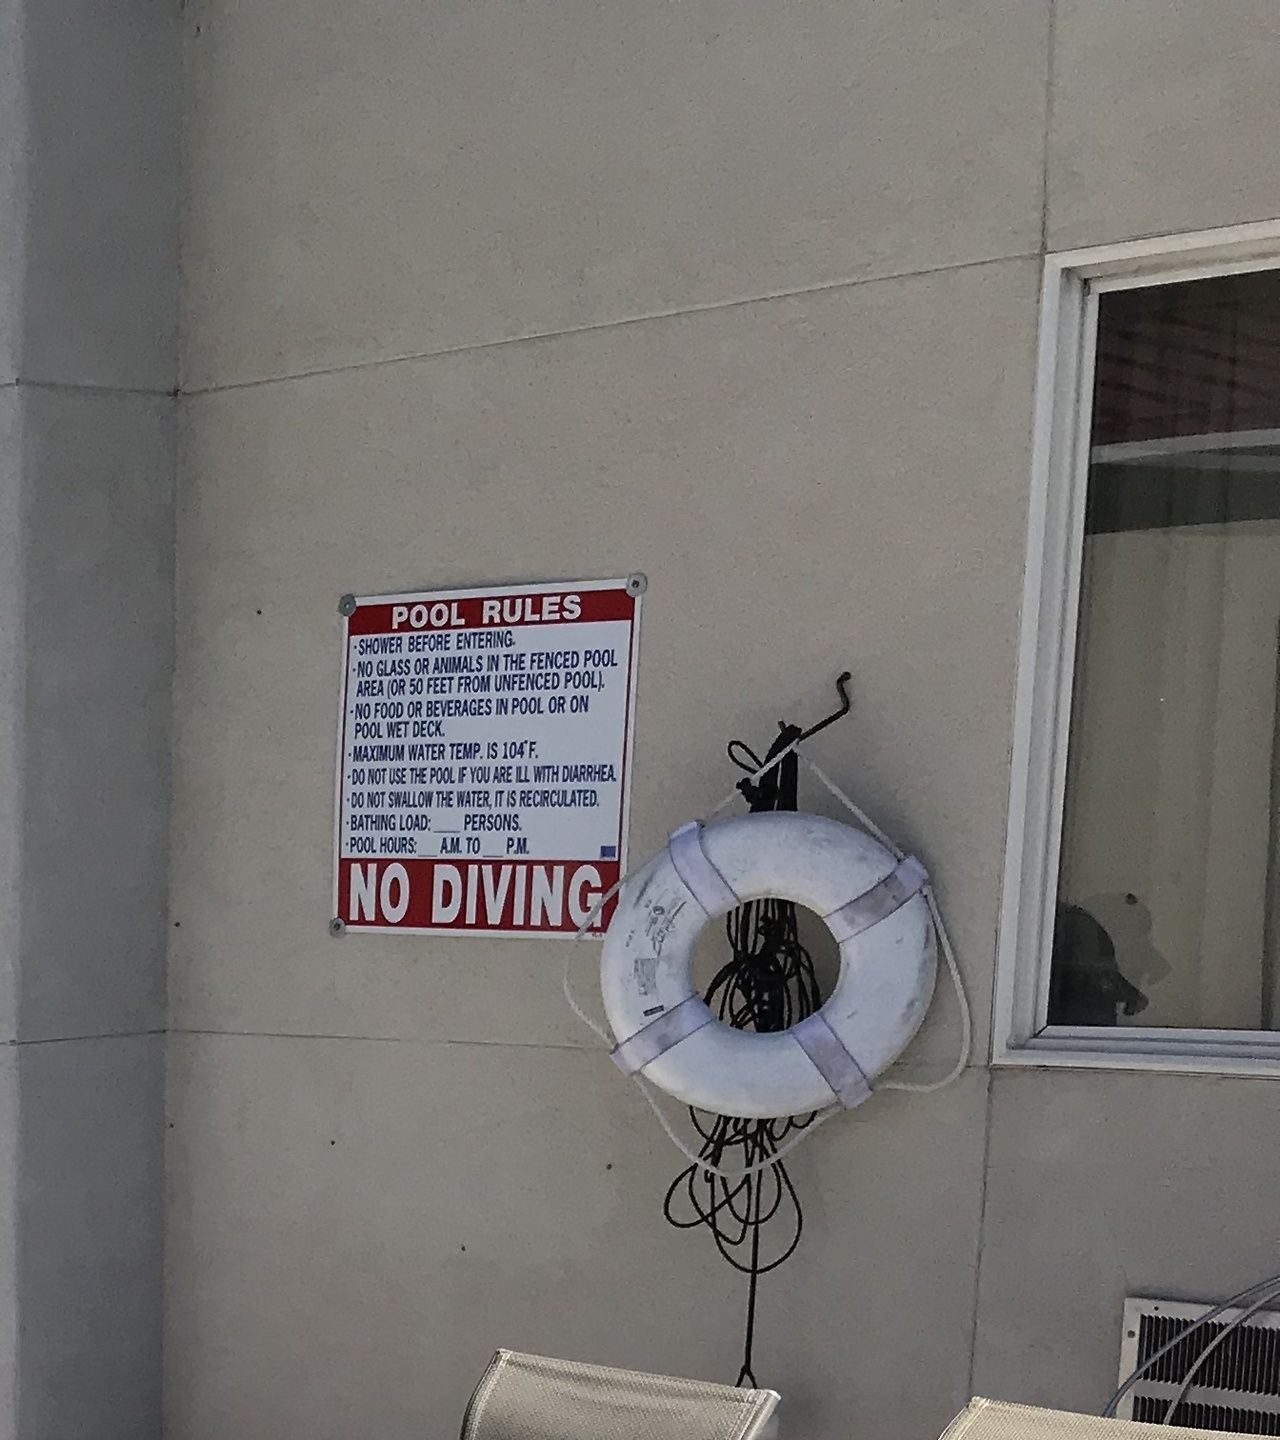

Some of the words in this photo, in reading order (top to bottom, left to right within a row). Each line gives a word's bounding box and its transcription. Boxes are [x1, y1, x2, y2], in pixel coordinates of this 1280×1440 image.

[392, 601, 465, 629] POOL
[482, 595, 581, 624] RULES
[359, 637, 402, 655] SHOWER
[408, 634, 450, 652] BEFORE
[457, 630, 515, 649] ENTERING.
[358, 661, 373, 677] NO
[376, 659, 411, 677] GLASS
[414, 658, 430, 675] OR
[434, 656, 483, 674] ANIMALS
[487, 655, 499, 672] IN
[505, 654, 526, 671] THE
[531, 652, 579, 670] FENCED
[584, 650, 617, 668] POOL
[357, 680, 384, 697] AREA
[388, 679, 406, 698] (OR
[409, 678, 423, 696] 50
[427, 677, 454, 695] FEET
[458, 676, 490, 694] FROM
[495, 673, 559, 693] UNFENCED
[565, 671, 605, 690] POOL).
[355, 704, 370, 719] NO
[376, 703, 403, 718] FOOD
[408, 702, 422, 717] OR
[427, 700, 492, 717] BEVERAGES
[496, 699, 508, 715] IN
[512, 698, 544, 714] POOL
[549, 697, 566, 713] OR
[572, 696, 589, 713] ON
[355, 722, 382, 739] POOL
[387, 721, 409, 738] WET
[413, 720, 445, 737] DECK.
[353, 744, 405, 762] MAXIMUM
[408, 743, 446, 761] WATER
[450, 742, 483, 760] TEMP.
[487, 742, 498, 759] IS
[352, 768, 366, 785] DO
[369, 768, 387, 785] NOT
[390, 768, 407, 785] USE
[410, 767, 427, 784] THE
[431, 767, 455, 784] POOL
[459, 767, 466, 784] IF
[471, 766, 490, 784] YOU
[494, 766, 512, 783] ARE
[516, 766, 530, 783] ILL
[533, 765, 558, 783] WITH
[563, 764, 616, 783] DIARRHEA.
[351, 793, 365, 808] DO
[368, 792, 385, 808] NOT
[389, 792, 433, 808] SWALLOW
[436, 792, 453, 808] THE
[457, 791, 492, 810] WATER,
[496, 791, 503, 807] IT
[507, 791, 516, 807] IS
[520, 790, 599, 807] RECIRCULATED.
[351, 815, 395, 831] BATHING
[400, 815, 431, 831] LOAD:
[464, 814, 521, 831] PERSONS.
[350, 838, 376, 854] POOL
[380, 838, 416, 854] HOURS:
[441, 838, 462, 854] A.M.
[466, 838, 480, 854] TO
[507, 838, 529, 854] P.M.
[350, 863, 410, 923] NO
[432, 864, 603, 928] DIVING
